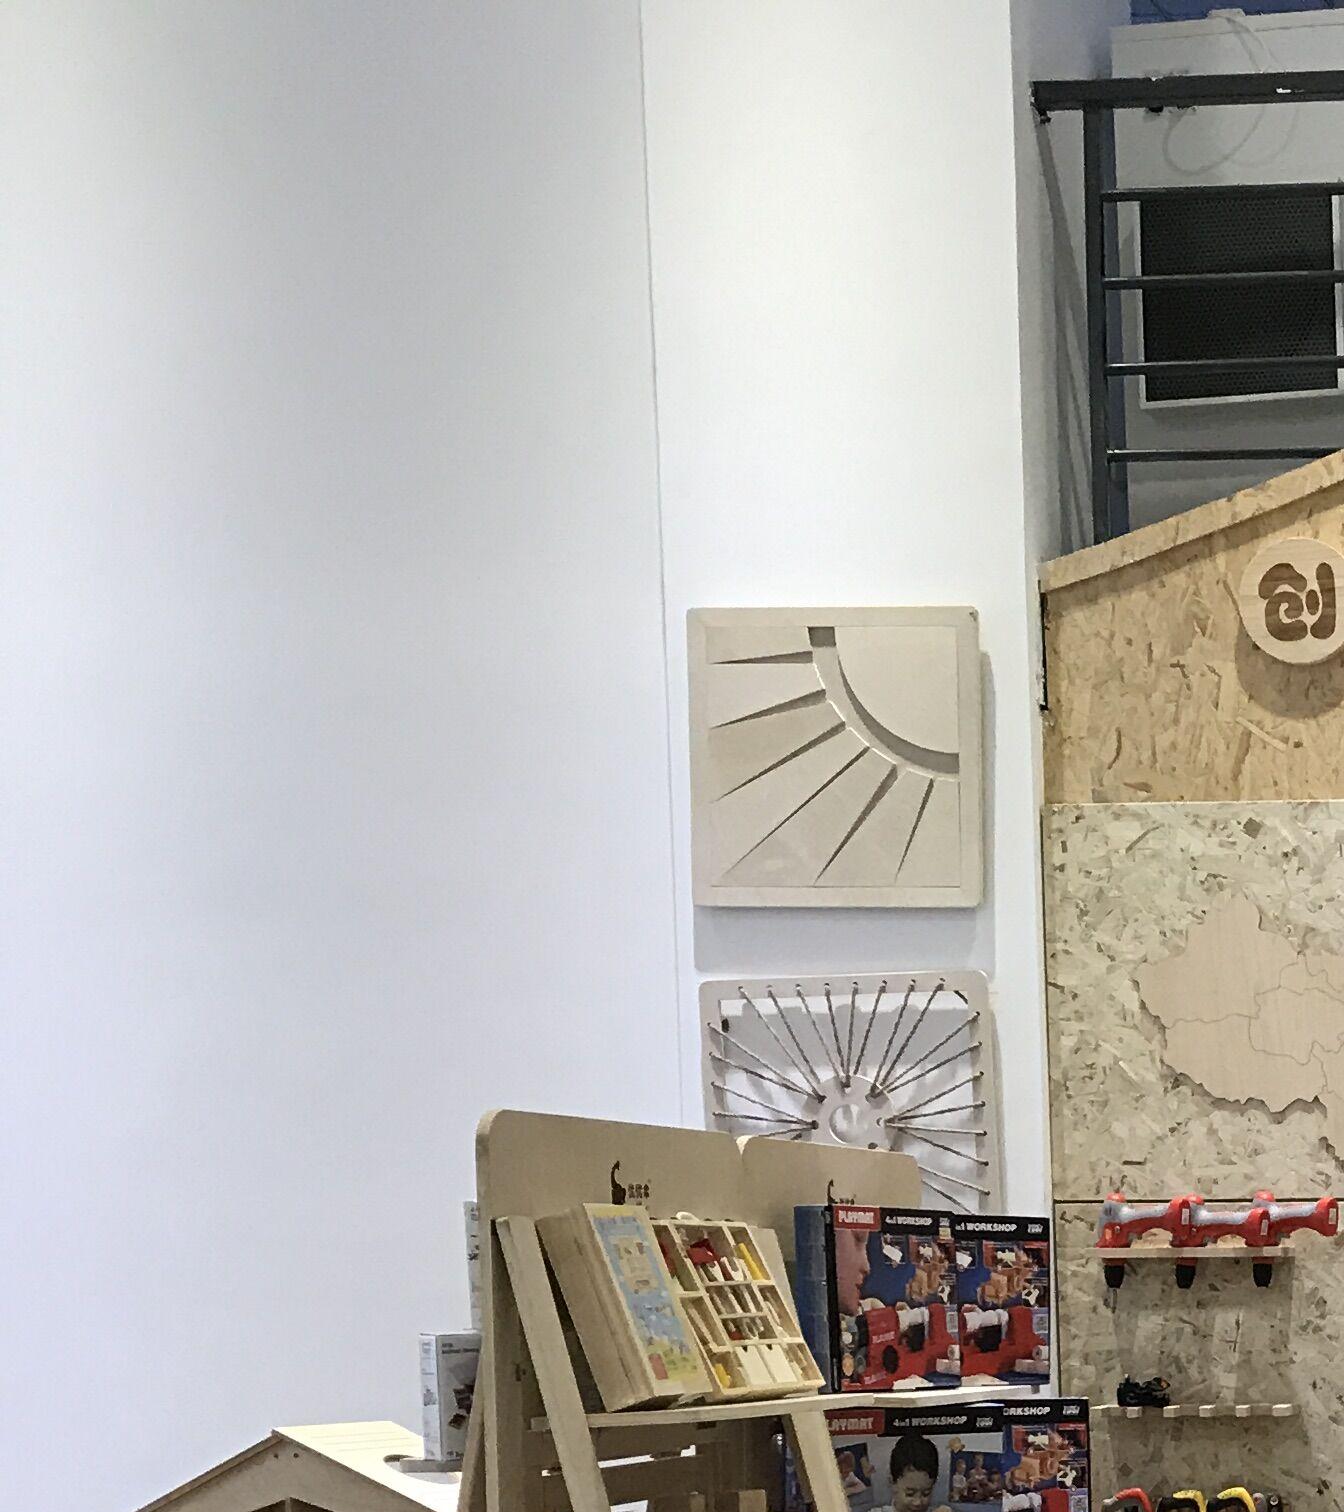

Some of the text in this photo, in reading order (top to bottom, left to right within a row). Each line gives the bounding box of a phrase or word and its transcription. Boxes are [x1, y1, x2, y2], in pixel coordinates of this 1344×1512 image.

[1258, 561, 1337, 642] 创
[966, 1222, 1018, 1232] WORKSHOP
[911, 1415, 968, 1428] WORKSHOP
